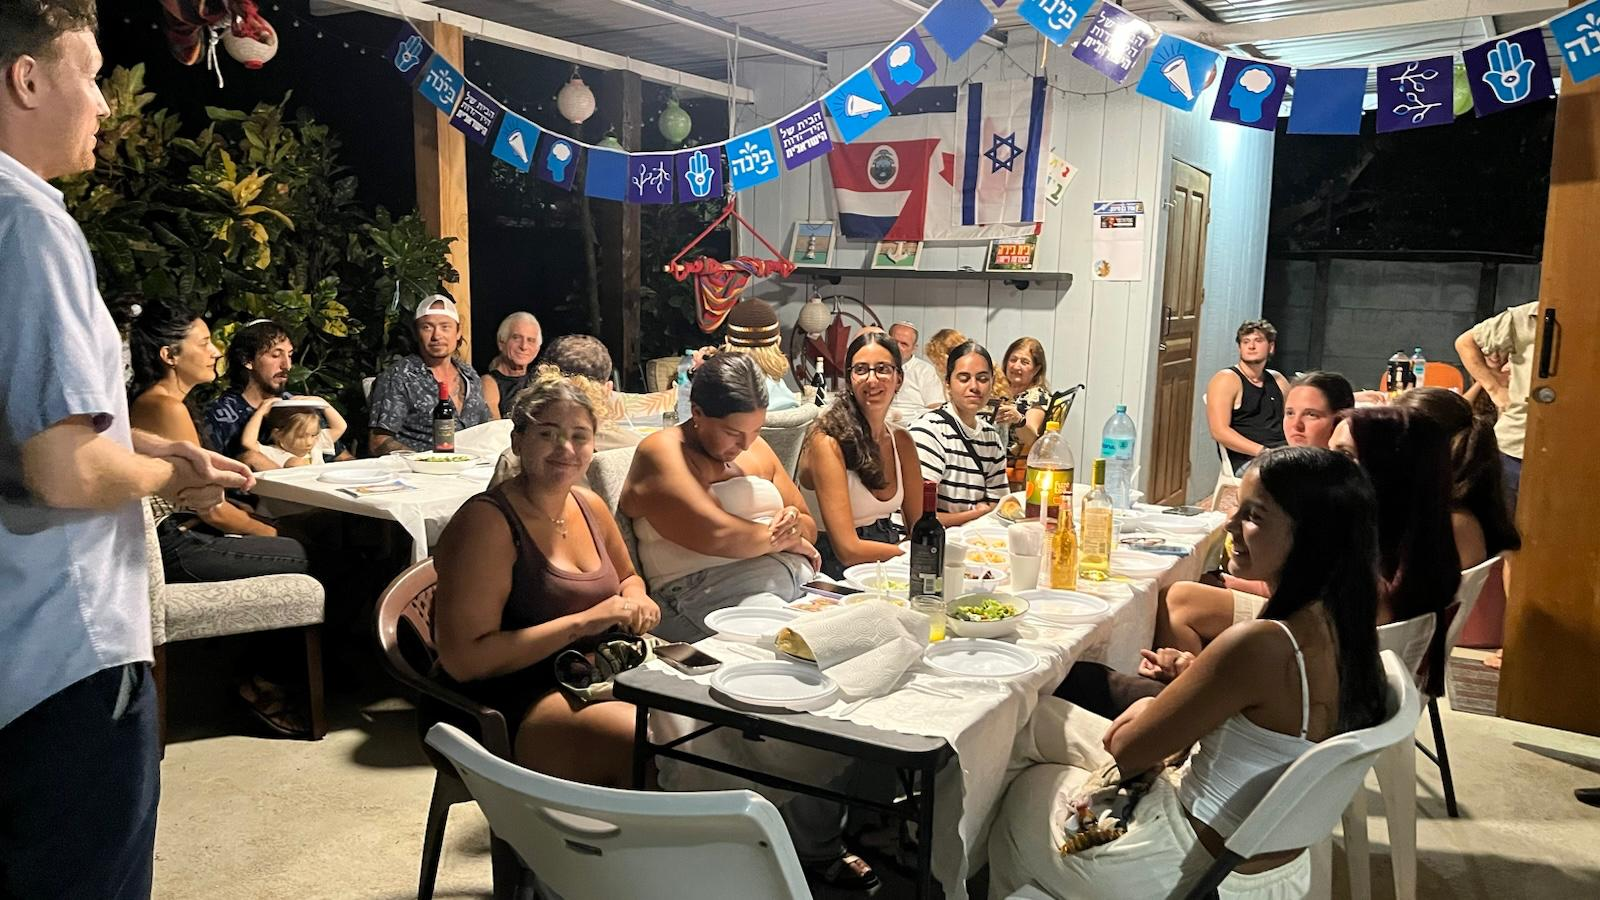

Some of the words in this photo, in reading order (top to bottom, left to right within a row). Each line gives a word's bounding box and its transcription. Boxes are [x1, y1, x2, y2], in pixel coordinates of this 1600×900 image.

[465, 91, 477, 104] של
[476, 103, 496, 119] הבית
[798, 112, 822, 130] הבית
[780, 126, 795, 139] של
[785, 131, 828, 158] הישראלית
[731, 148, 774, 176] בינה
